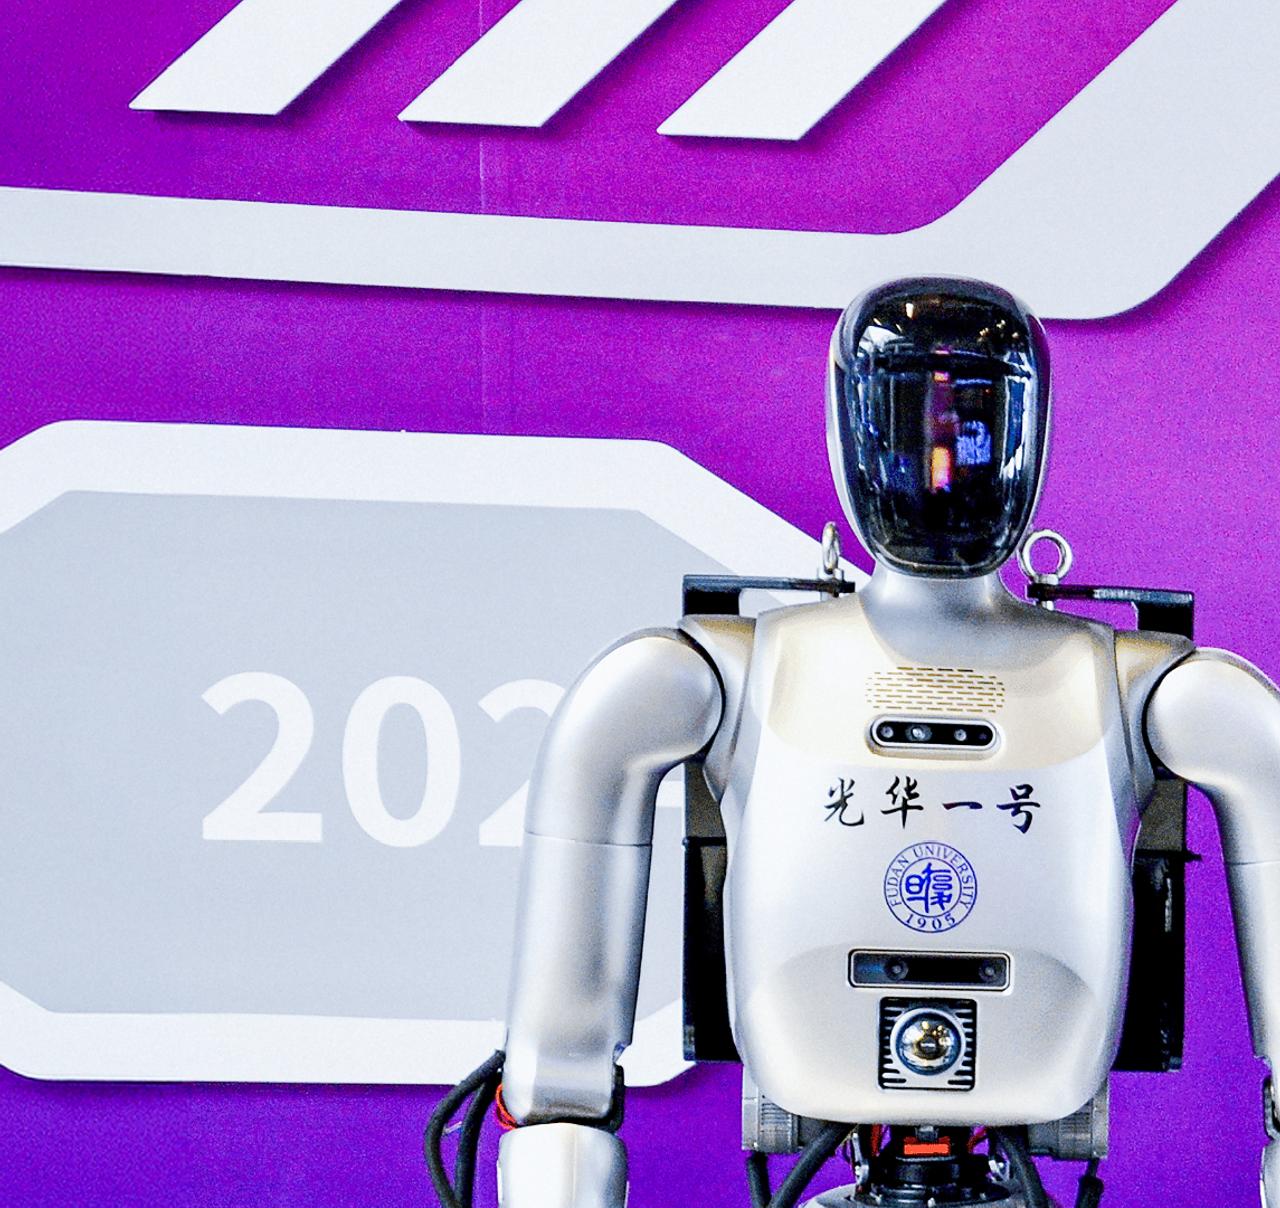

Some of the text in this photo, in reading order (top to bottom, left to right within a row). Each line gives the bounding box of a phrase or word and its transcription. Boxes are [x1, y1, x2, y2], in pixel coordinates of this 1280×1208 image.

[824, 776, 1041, 834] 光华一号
[886, 845, 974, 909] FUDAN UNIVERSITY
[906, 913, 956, 931] 1905
